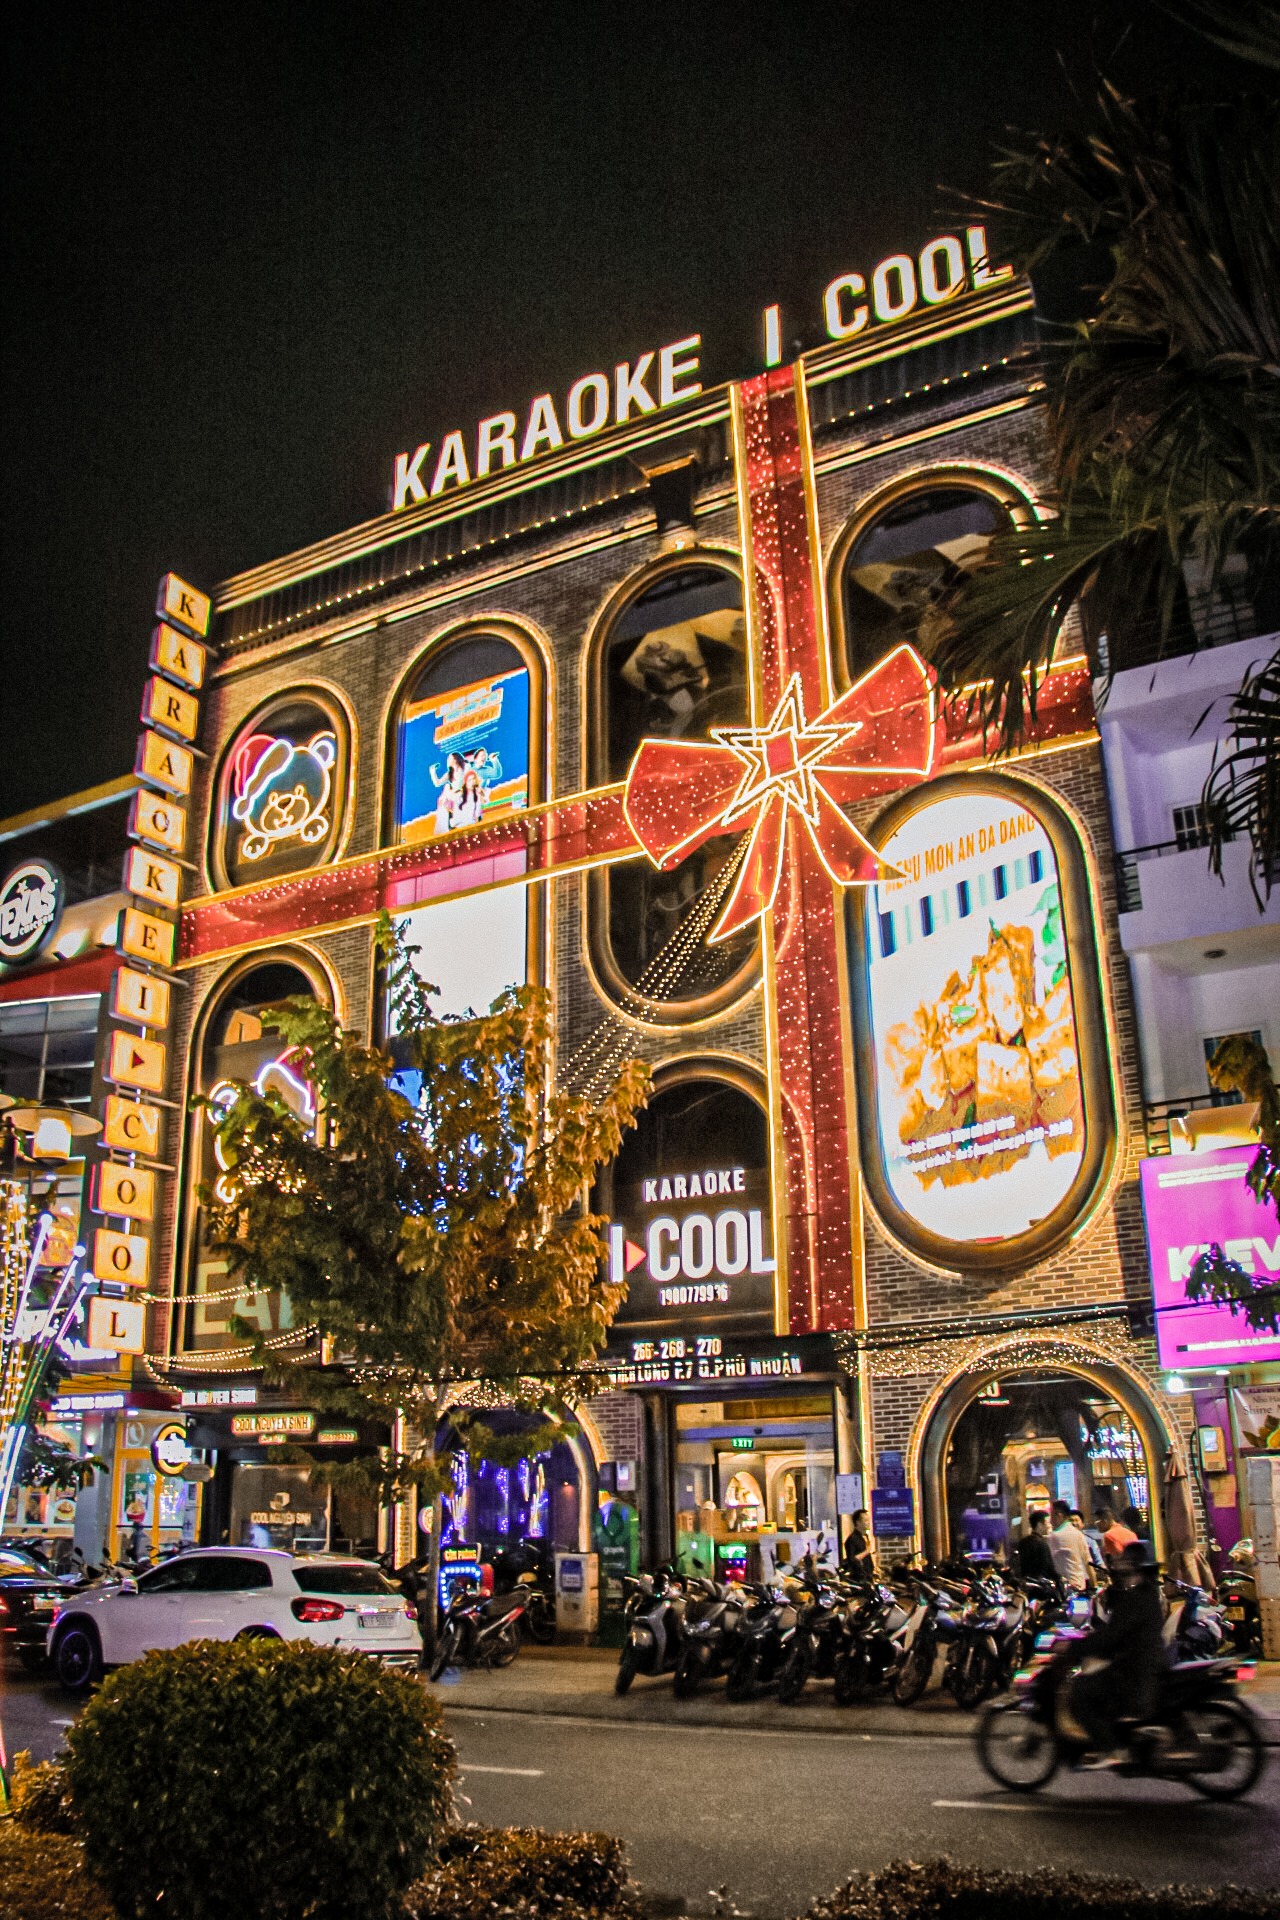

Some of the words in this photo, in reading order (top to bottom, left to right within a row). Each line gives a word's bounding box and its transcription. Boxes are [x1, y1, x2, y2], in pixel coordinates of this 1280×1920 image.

[393, 334, 703, 512] KARAOKE
[763, 303, 782, 368] I
[823, 225, 1014, 339] COOL
[885, 852, 920, 896] NU
[0, 881, 55, 940] EXAS
[645, 1168, 746, 1203] KARAOKE
[648, 1209, 777, 1282] COOL
[1167, 1235, 1280, 1282] KEV
[750, 1352, 801, 1378] NHUẬN
[731, 1438, 753, 1448] EXIT
